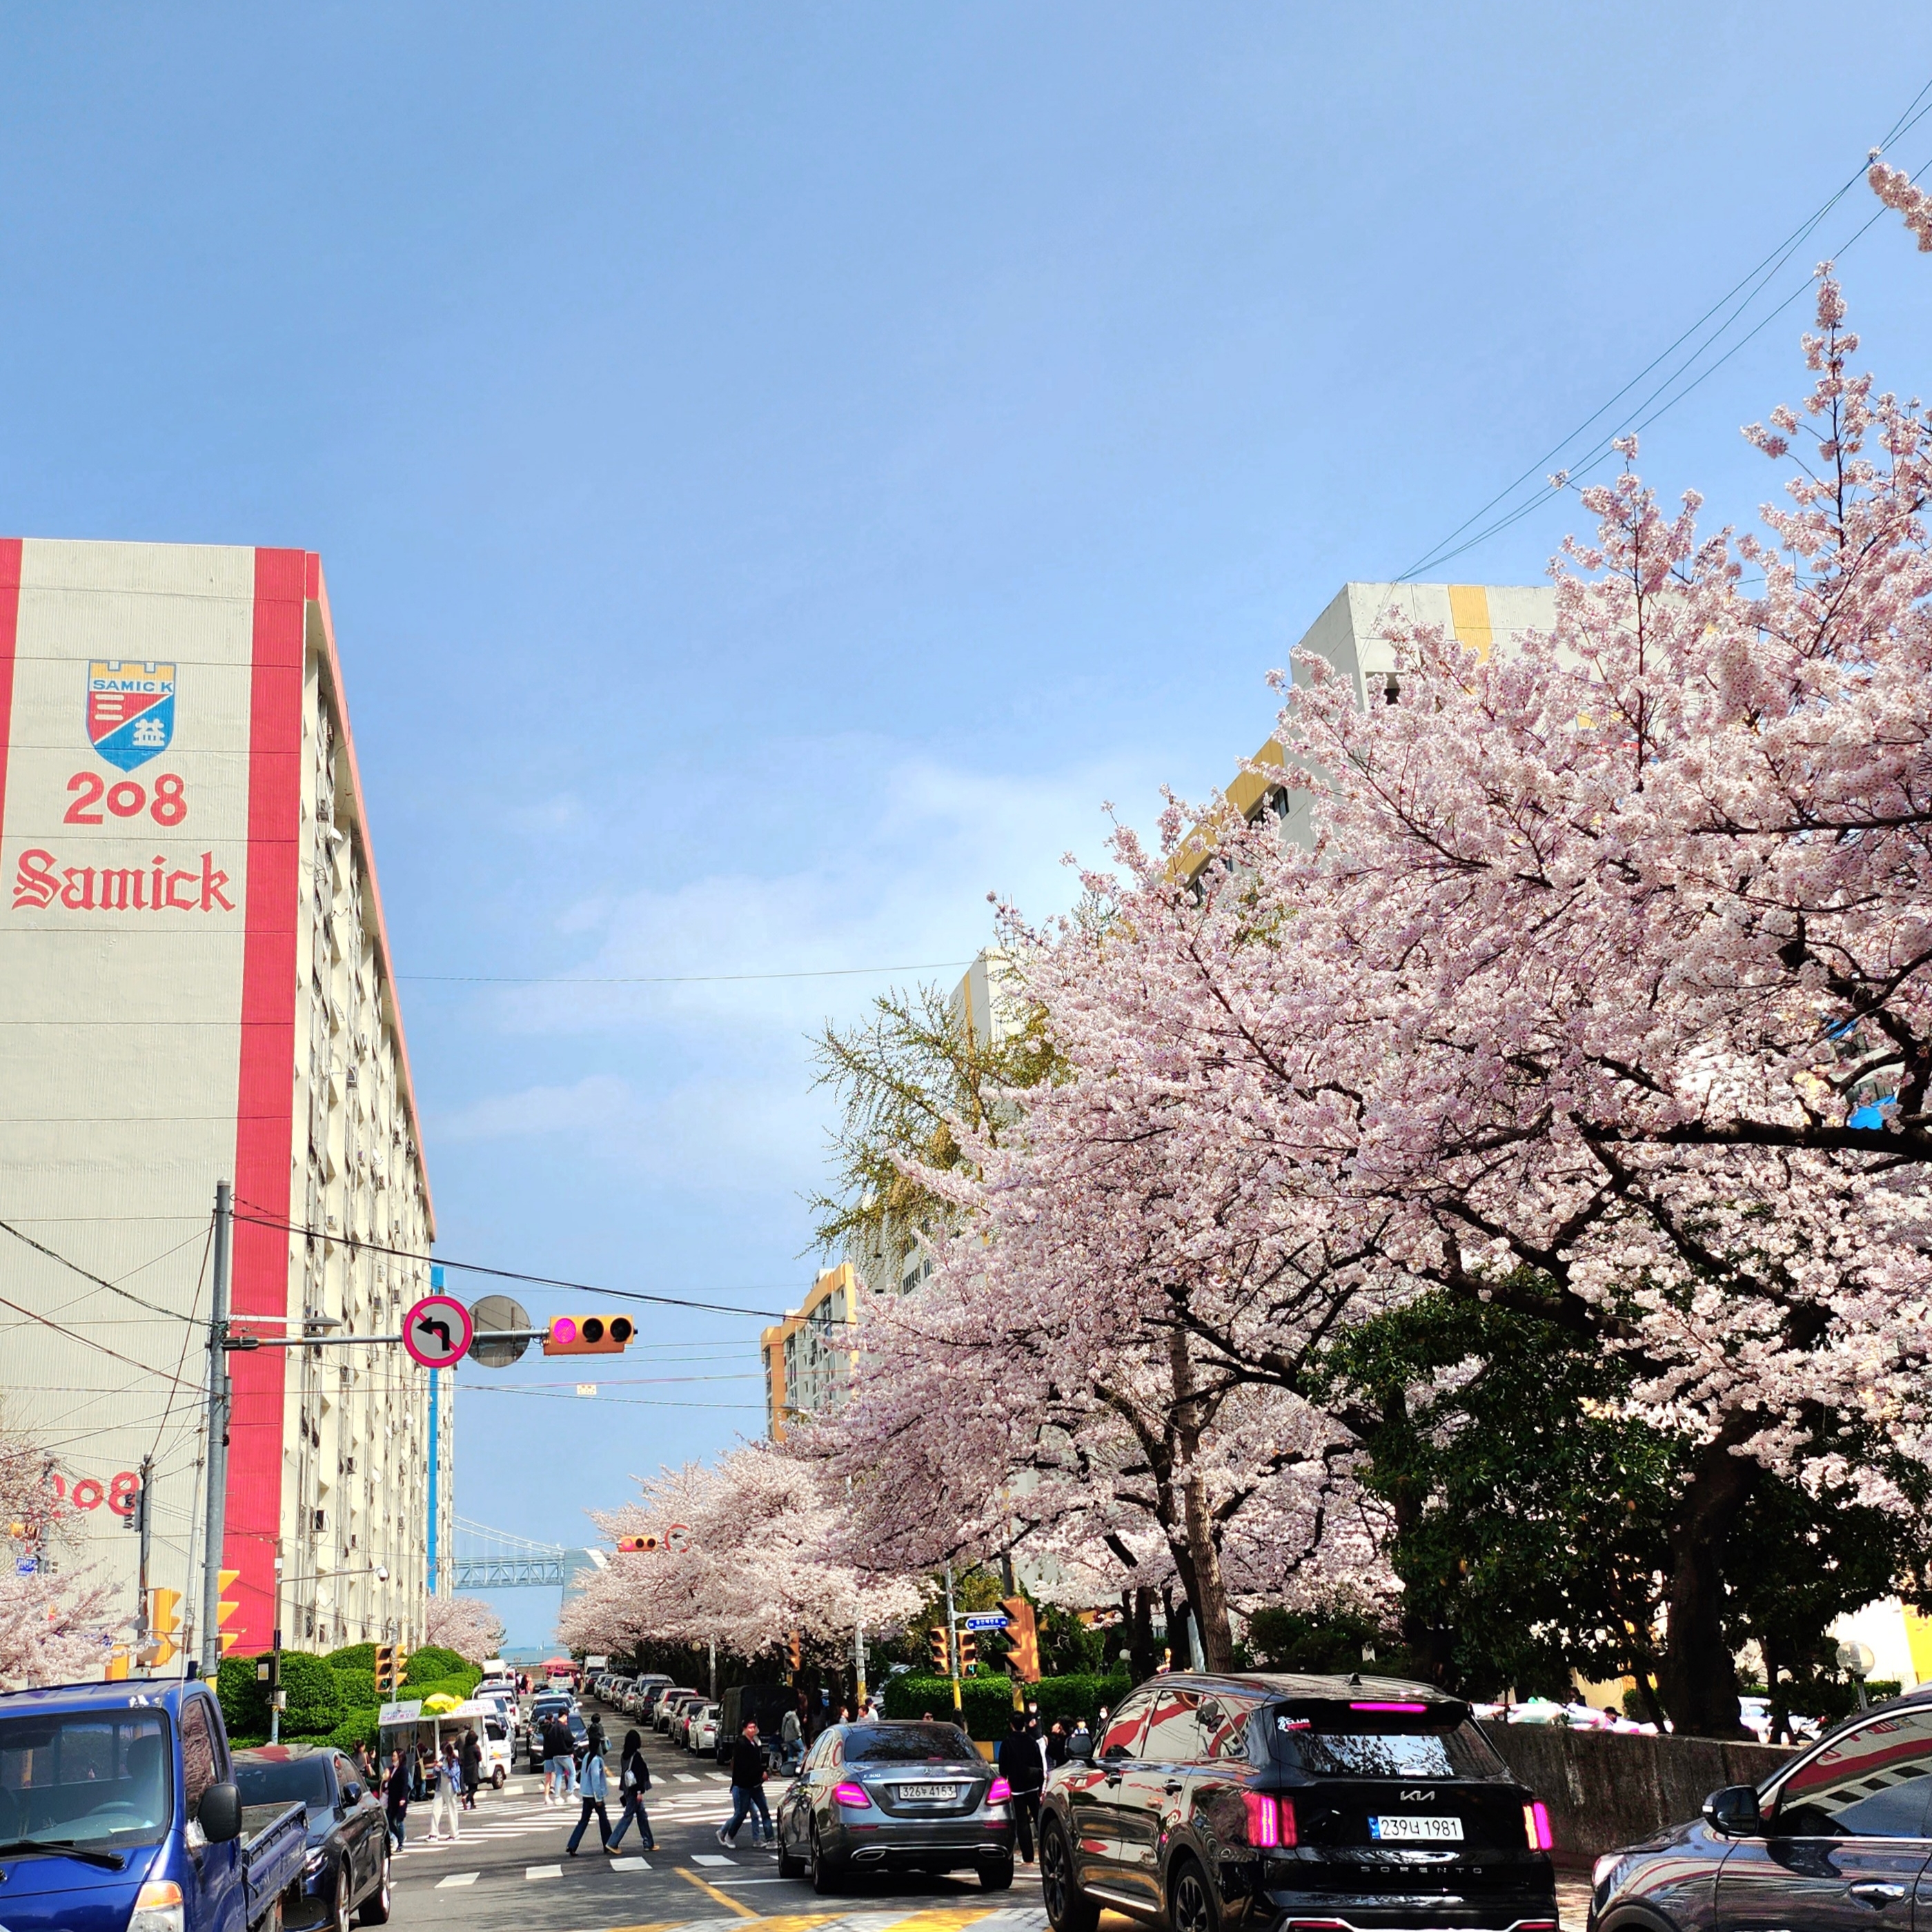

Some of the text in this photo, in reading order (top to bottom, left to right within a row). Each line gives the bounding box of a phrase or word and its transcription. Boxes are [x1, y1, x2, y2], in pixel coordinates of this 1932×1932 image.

[92, 679, 173, 692] SAMICK
[63, 771, 188, 827] 208
[12, 849, 236, 912] Samick
[968, 1664, 974, 1674] 4
[929, 1786, 954, 1797] 4153
[1424, 1820, 1458, 1837] 1981
[1360, 1866, 1482, 1874] SORENTO
